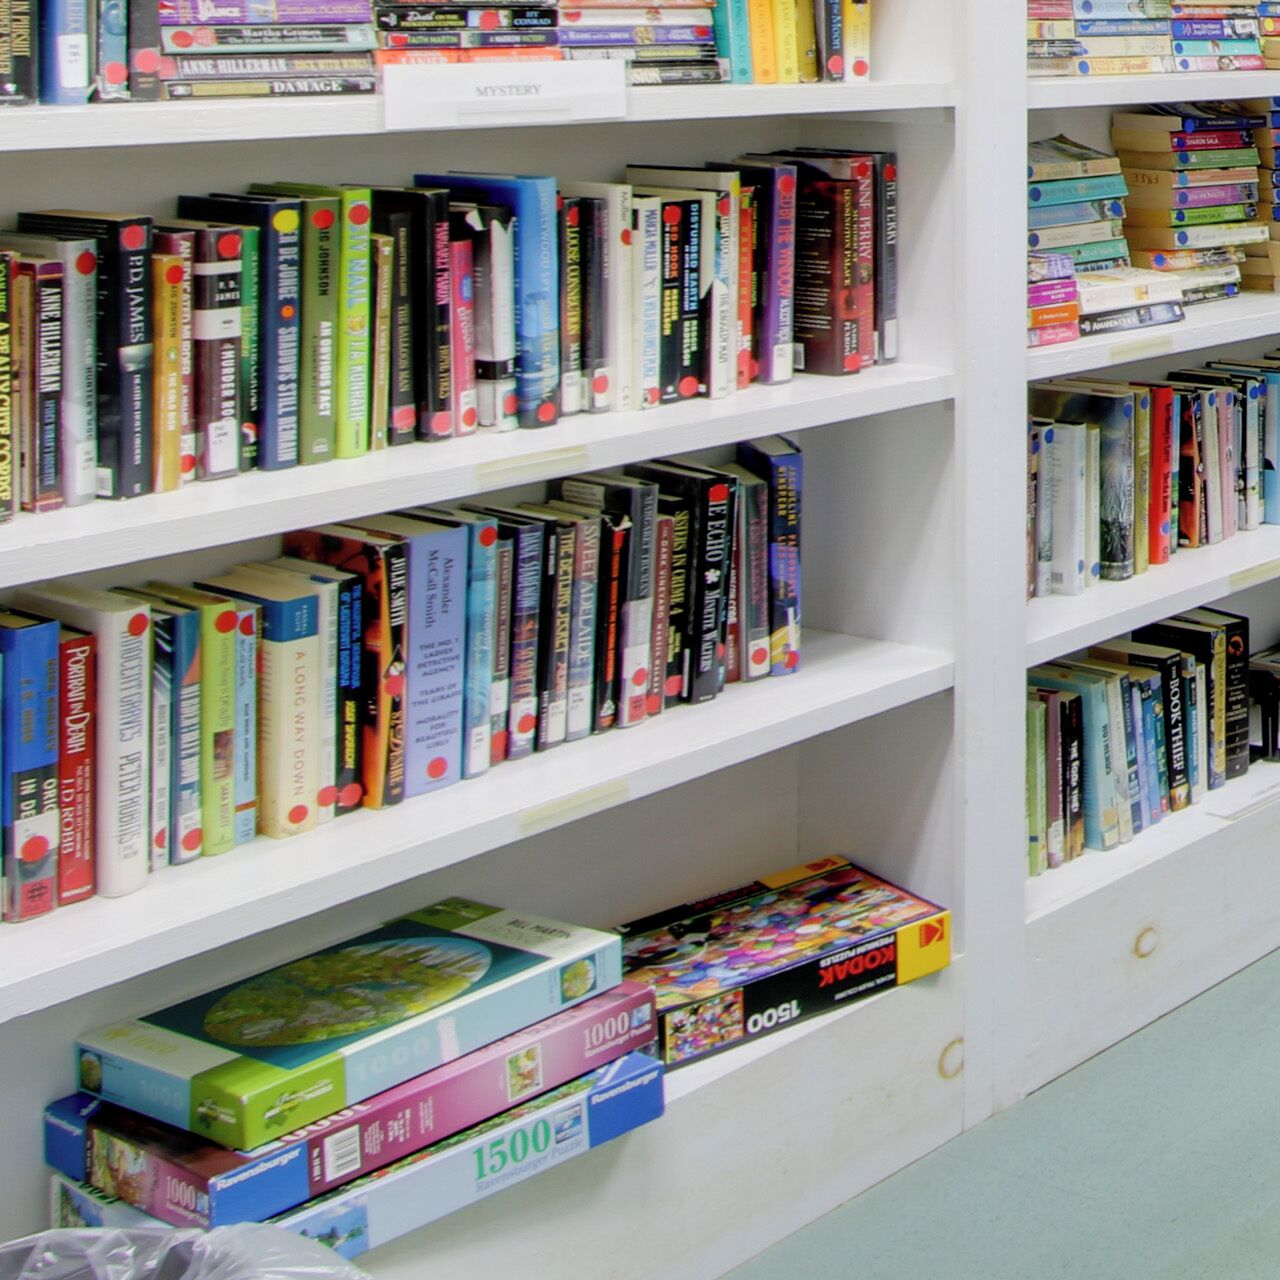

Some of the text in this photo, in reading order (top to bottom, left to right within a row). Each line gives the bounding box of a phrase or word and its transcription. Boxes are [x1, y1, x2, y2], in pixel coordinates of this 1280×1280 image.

[182, 58, 287, 74] ANNE HILLERMAN
[273, 80, 342, 93] DAMAGE
[475, 82, 542, 98] MYSTERY
[130, 254, 146, 343] P.D. JAMES
[215, 289, 240, 302] JAMES
[40, 287, 62, 393] ANNE HILLERMAN
[390, 558, 407, 627] JULIE SMITH
[819, 947, 894, 988] KODAK
[748, 1000, 801, 1033] 1500
[216, 1147, 302, 1191] Ravensburger
[472, 1121, 552, 1179] 1500
[165, 1175, 196, 1210] 1000
